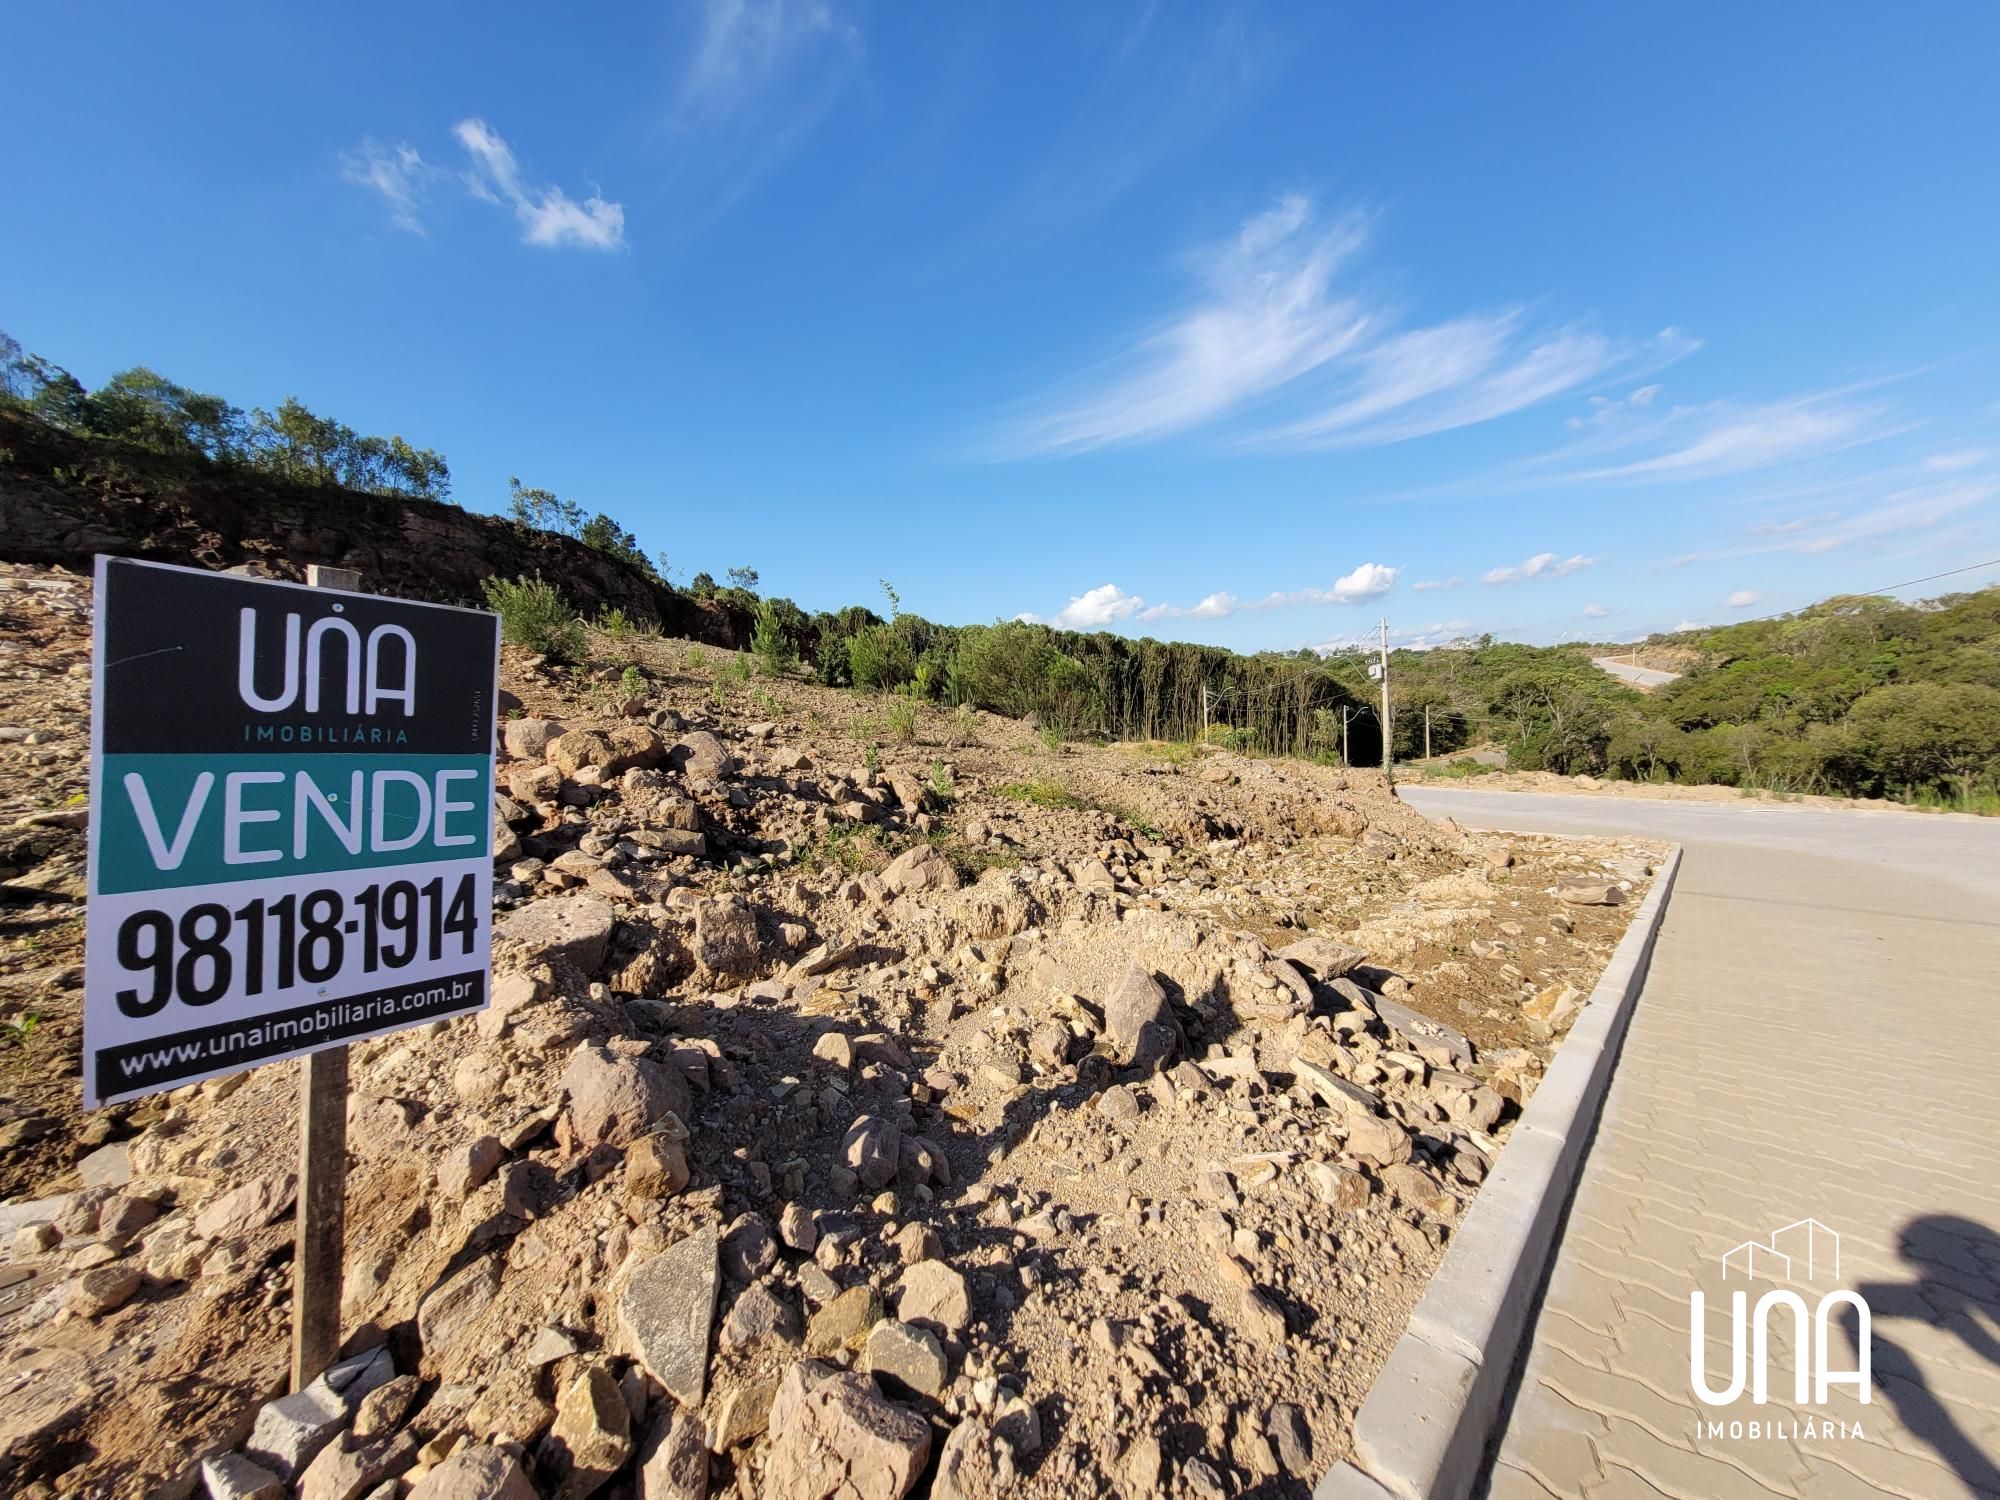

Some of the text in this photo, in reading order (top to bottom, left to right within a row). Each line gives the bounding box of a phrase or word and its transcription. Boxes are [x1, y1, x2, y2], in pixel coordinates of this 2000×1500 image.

[238, 607, 416, 716] UNA
[245, 723, 407, 743] IMOBILIÁRIA
[124, 769, 478, 869] VENDE
[116, 873, 478, 1018] 98118-1914
[120, 981, 472, 1076] www.unaimobiliaria.com.br
